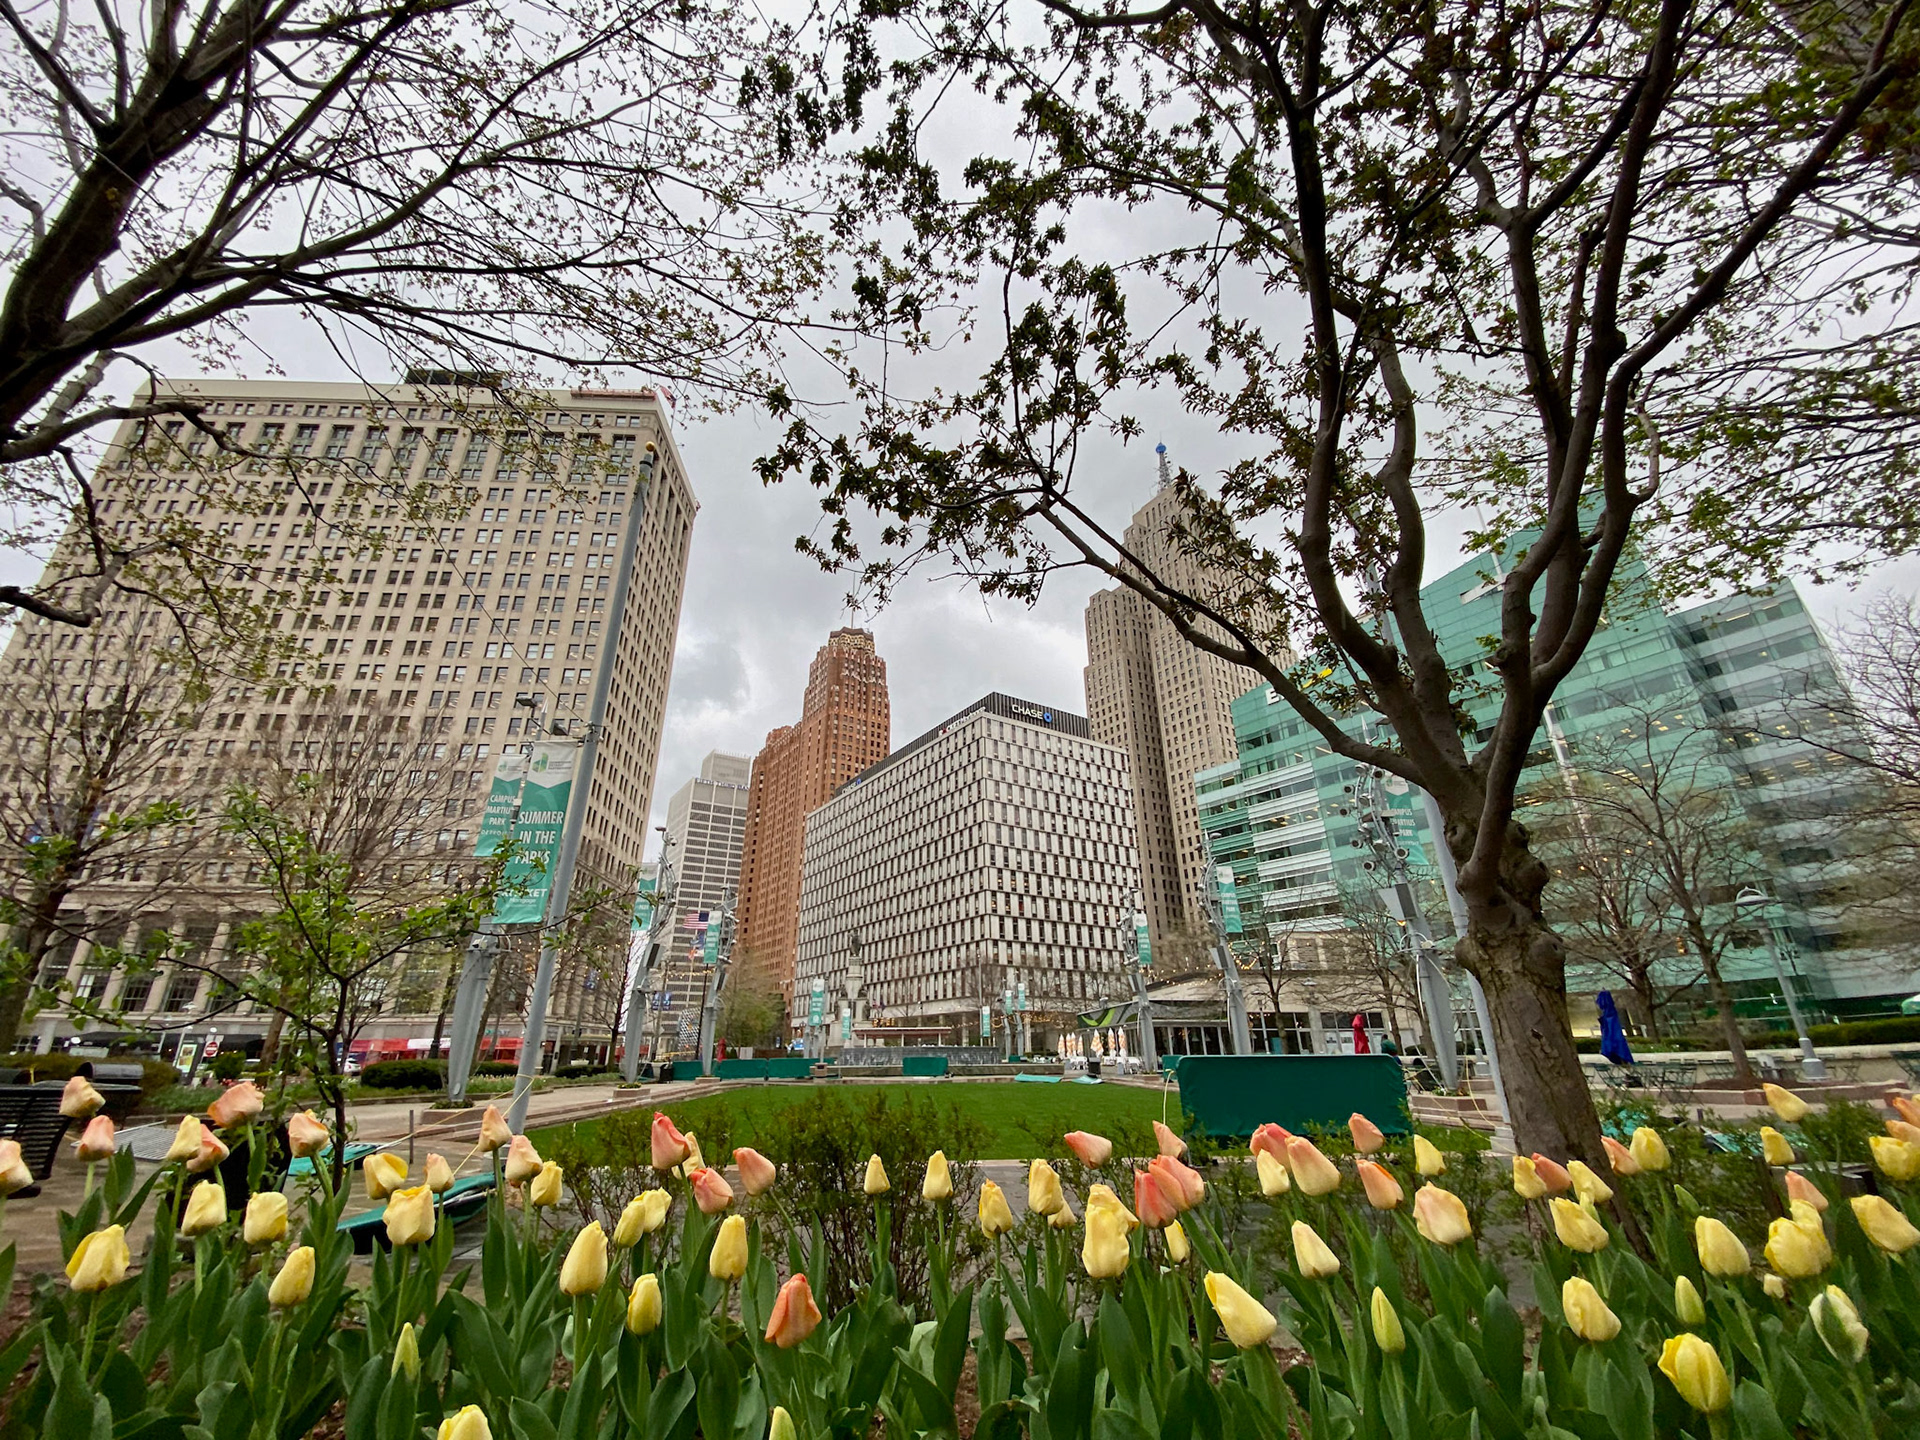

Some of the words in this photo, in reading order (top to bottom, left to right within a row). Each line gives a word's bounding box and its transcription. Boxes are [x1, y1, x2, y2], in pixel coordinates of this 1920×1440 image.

[1265, 687, 1285, 704] E
[1011, 704, 1043, 720] CHASE
[486, 805, 513, 814] MARTIU
[489, 817, 506, 826] PARK
[518, 811, 564, 824] SUMMER
[519, 830, 532, 844] IN
[535, 830, 556, 844] THE
